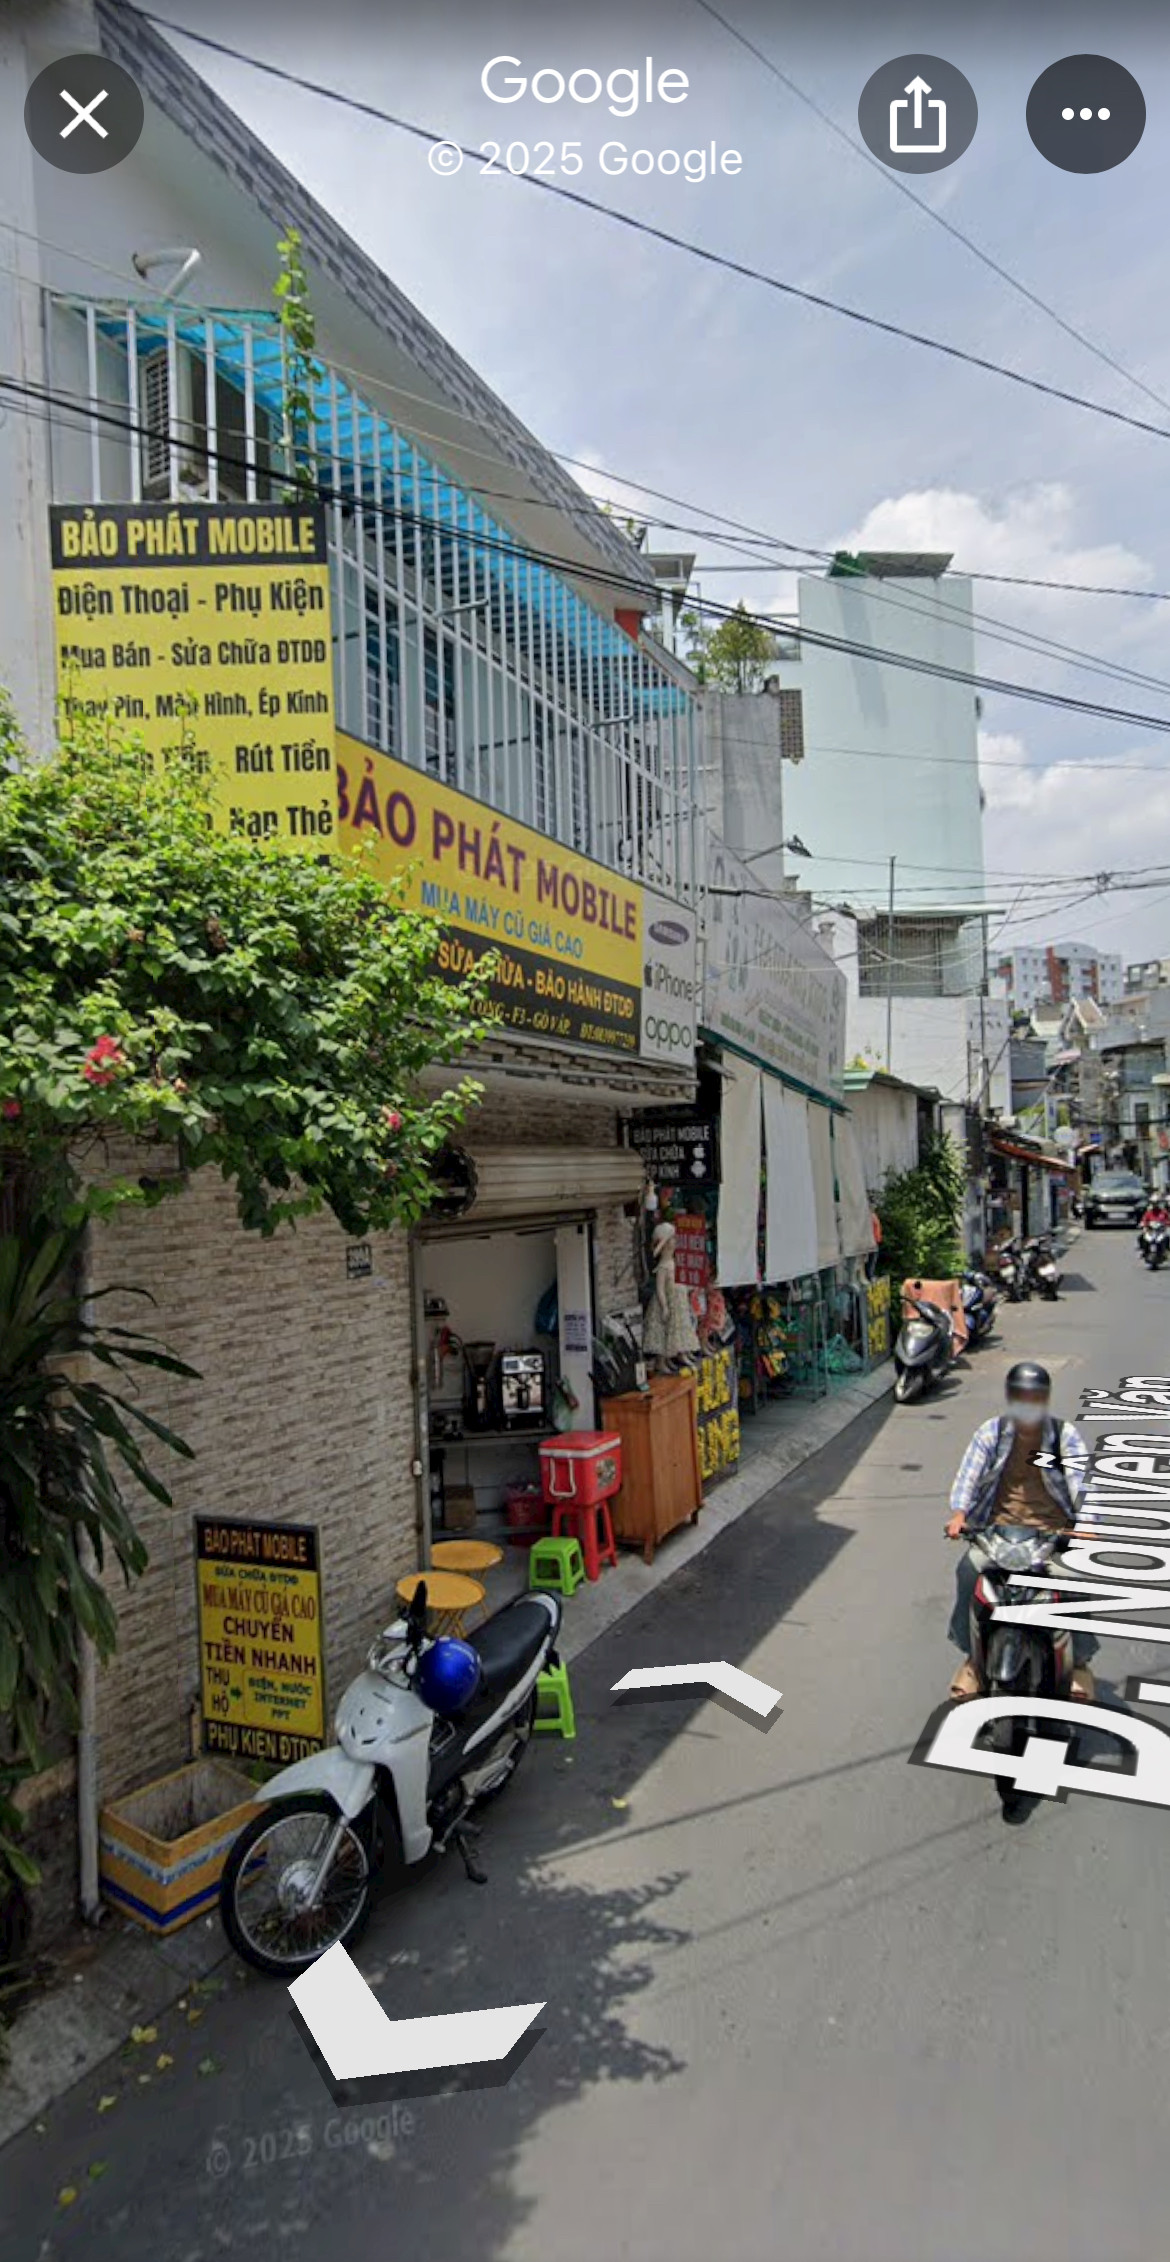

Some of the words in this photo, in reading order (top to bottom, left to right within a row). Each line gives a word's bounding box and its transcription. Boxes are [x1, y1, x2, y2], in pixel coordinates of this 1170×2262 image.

[60, 508, 118, 557] BẢO
[126, 510, 199, 556] PHÁT
[207, 517, 315, 555] MOBILE
[58, 582, 113, 621] Điện
[121, 582, 189, 619] Thoại
[215, 582, 261, 618] Phụ
[270, 578, 323, 616] Kiện
[112, 641, 150, 668] Bán
[171, 636, 210, 667] Sửa
[217, 638, 270, 665] Chữa
[204, 691, 252, 717] Hình,
[259, 687, 280, 717] Ép
[287, 690, 328, 715] Kính
[235, 742, 274, 773] Rút
[281, 738, 330, 772] Tiền
[286, 799, 333, 836] Thẻ
[431, 808, 525, 894] PHÁT
[537, 858, 636, 941] MOBILE
[465, 896, 500, 930] MÁY
[528, 920, 552, 949] GIÁ
[555, 931, 583, 959] CAO
[535, 967, 566, 1000] BẢO
[654, 963, 692, 1002] iPhone
[677, 1125, 709, 1142] MOBILE
[230, 1526, 260, 1557] PHÁT
[263, 1533, 307, 1562] MOBILE
[292, 1594, 315, 1621] CAO
[252, 1648, 316, 1676] NHANH
